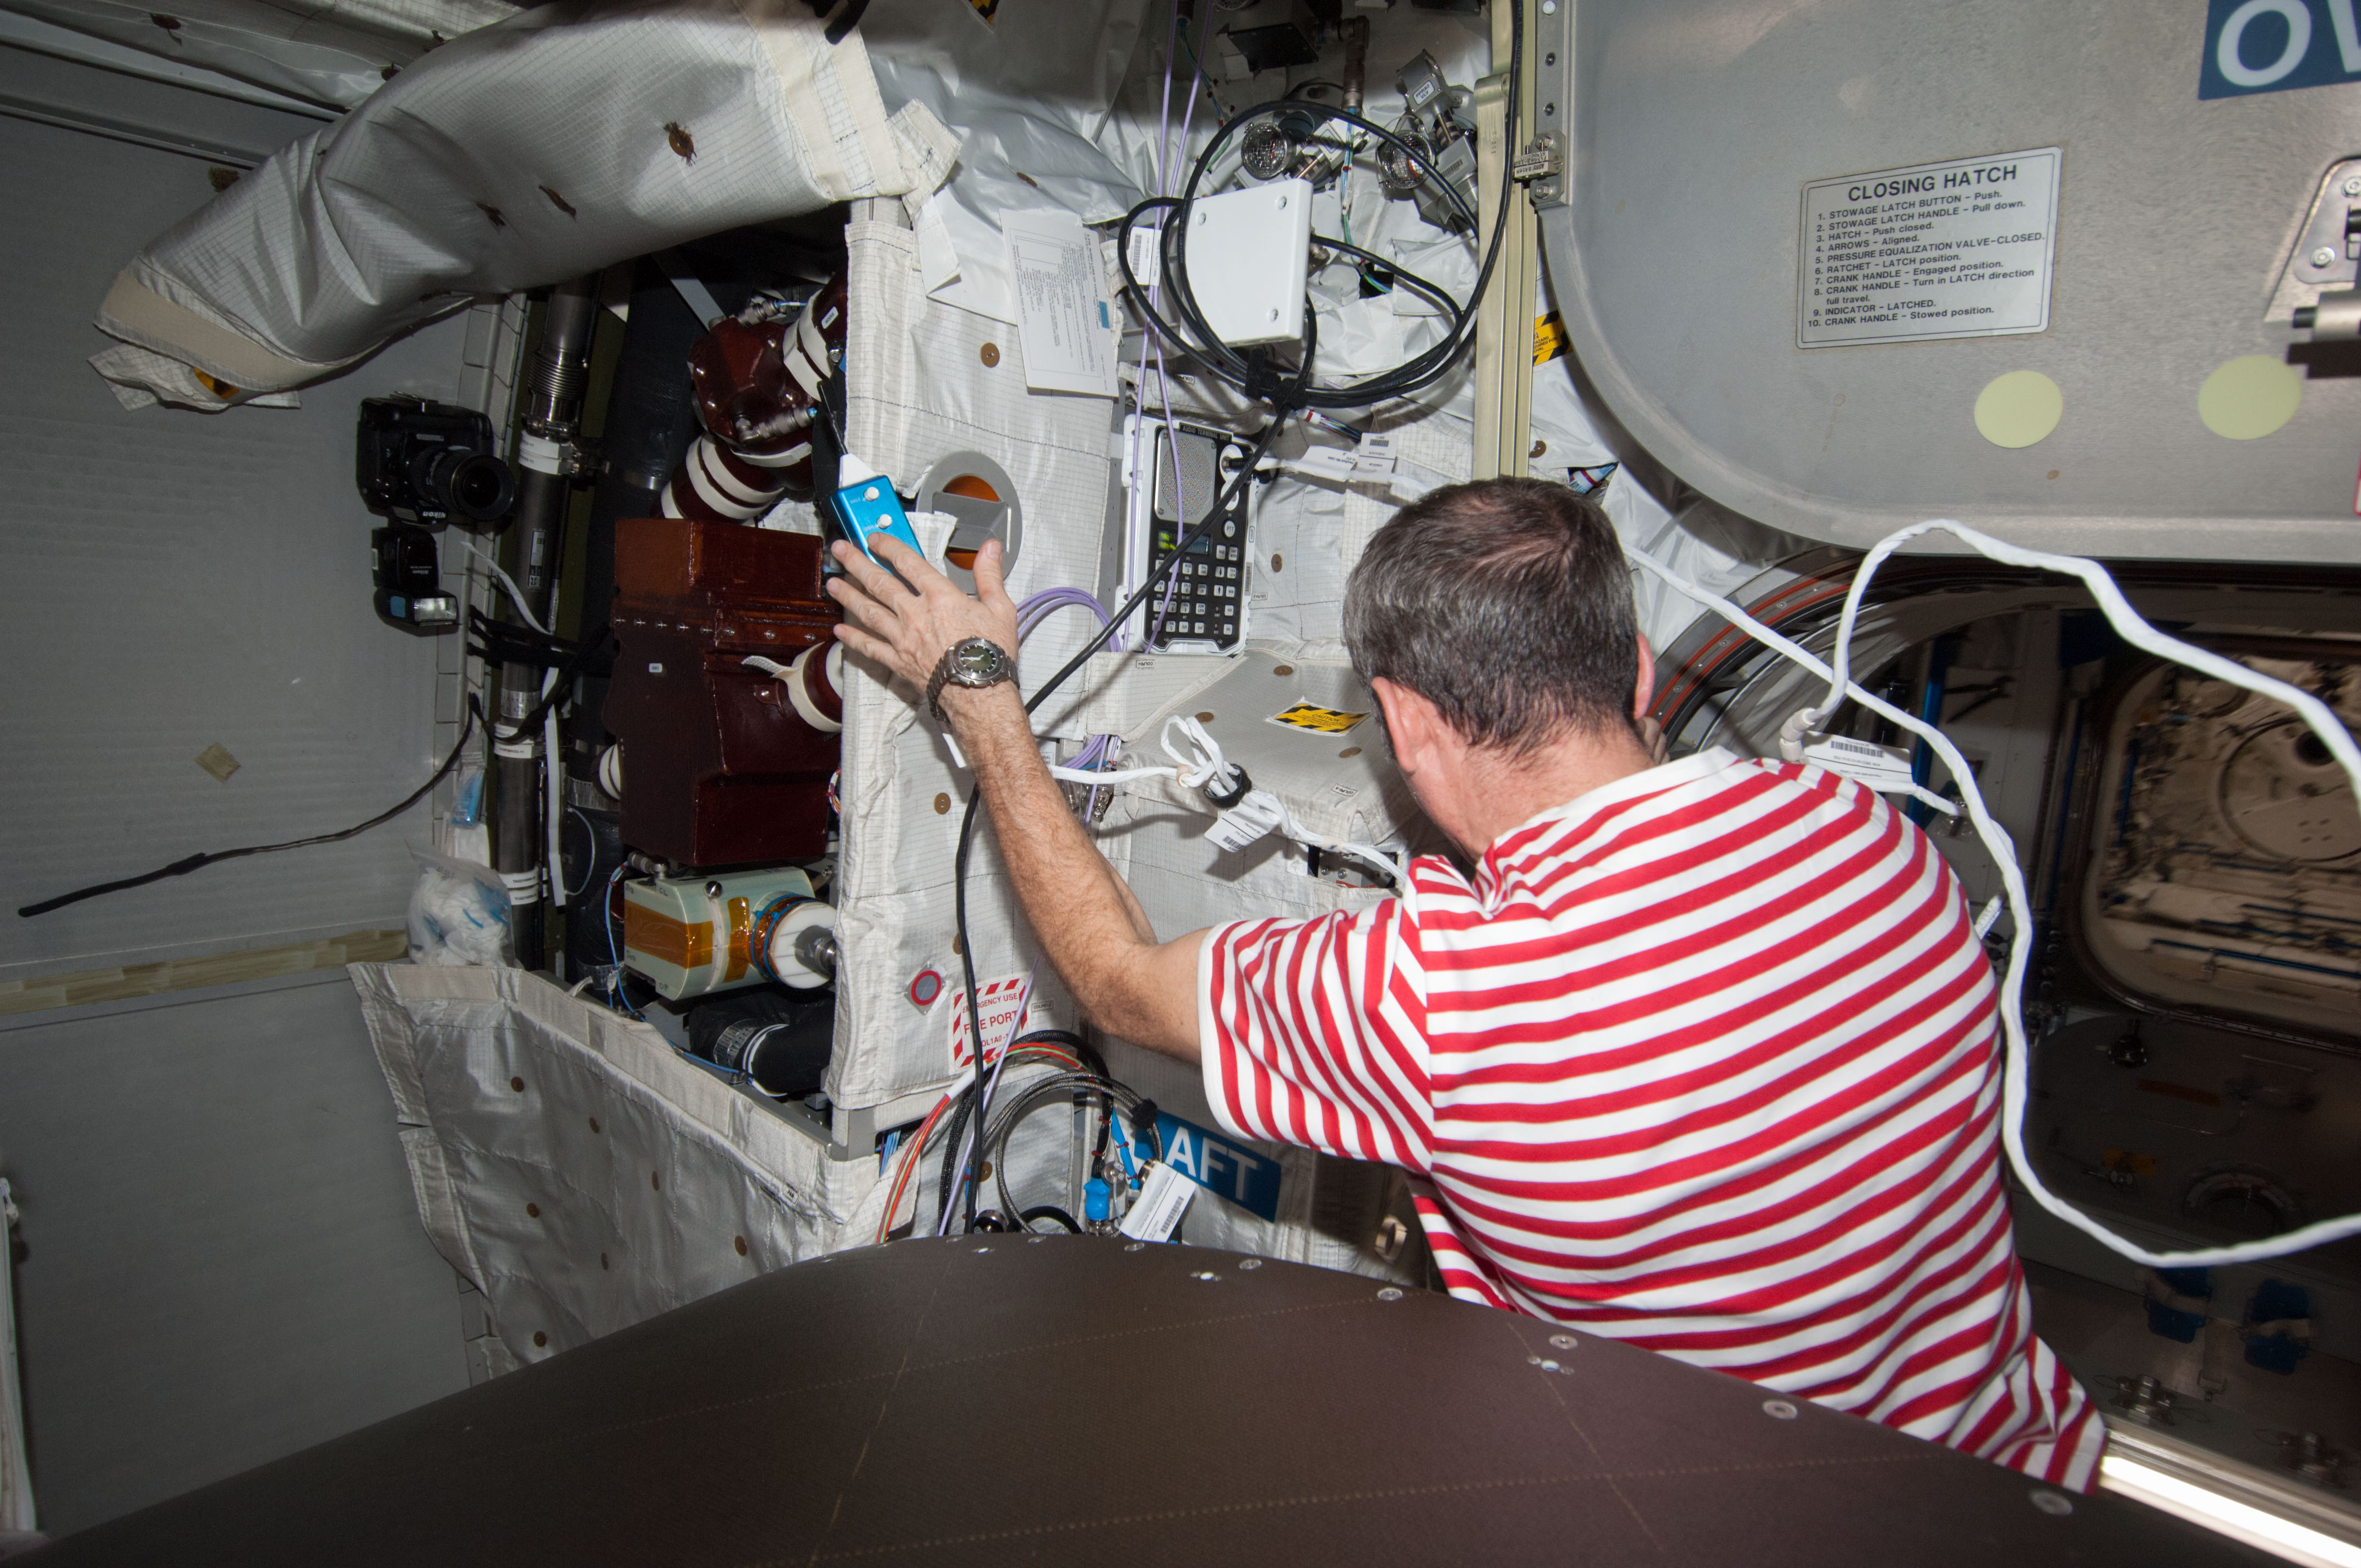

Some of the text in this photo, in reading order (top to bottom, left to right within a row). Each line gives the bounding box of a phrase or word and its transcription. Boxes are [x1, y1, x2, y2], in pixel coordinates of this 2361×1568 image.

[1848, 164, 2017, 202] CLOSING HATCH
[1829, 205, 1879, 219] STOWAGE
[1881, 200, 1916, 213] LATCH
[1919, 194, 1961, 208] BUTTON
[1974, 190, 2002, 200] Push.
[1816, 224, 1825, 232] 2.
[1829, 217, 1878, 231] STOWAGE
[1881, 213, 1914, 224] LATCH
[1918, 206, 1960, 220] HANDLE
[1972, 203, 1990, 213] Pull
[1994, 200, 2026, 210] down.
[1816, 235, 1825, 243] 3.
[1829, 230, 1861, 241] HATCH
[1873, 226, 1895, 236] Push
[1898, 221, 1934, 233] closed.
[1827, 239, 1870, 252] ARROWS
[1881, 234, 1920, 246] Aligned.
[1815, 232, 2045, 264] 5. PRESSURE EQUALIZATION VALVE-CLOSED.
[1815, 267, 1823, 275] 6.
[1827, 262, 1872, 274] RATCHET
[1883, 257, 1916, 268] LATCH
[1919, 254, 1961, 266] position.
[1826, 274, 1859, 284] CRANK
[1862, 269, 1901, 281] HANDLE
[1913, 264, 1956, 276] Engaged
[1960, 261, 2004, 273] position.
[1826, 284, 1858, 295] CRANK
[1862, 280, 1901, 291] HANDLE
[1912, 279, 1934, 287] Turn
[1949, 273, 1985, 284] LATCH
[1988, 269, 2034, 280] direction
[1825, 304, 1876, 316] INDICATOR
[1887, 300, 1936, 311] LATCHED.
[1826, 294, 1870, 305] full travel.
[1825, 316, 1857, 326] CRANK
[1860, 313, 1898, 323] HANDLE
[1910, 309, 1947, 319] Stowed
[1951, 307, 1994, 318] position.
[1182, 425, 1196, 433] AUDIO
[1198, 429, 1217, 439] TERMINAL
[962, 993, 1018, 1014] EMRGENCY USE
[964, 1010, 1018, 1035] FIE PORT
[1164, 1126, 1257, 1201] AFT
